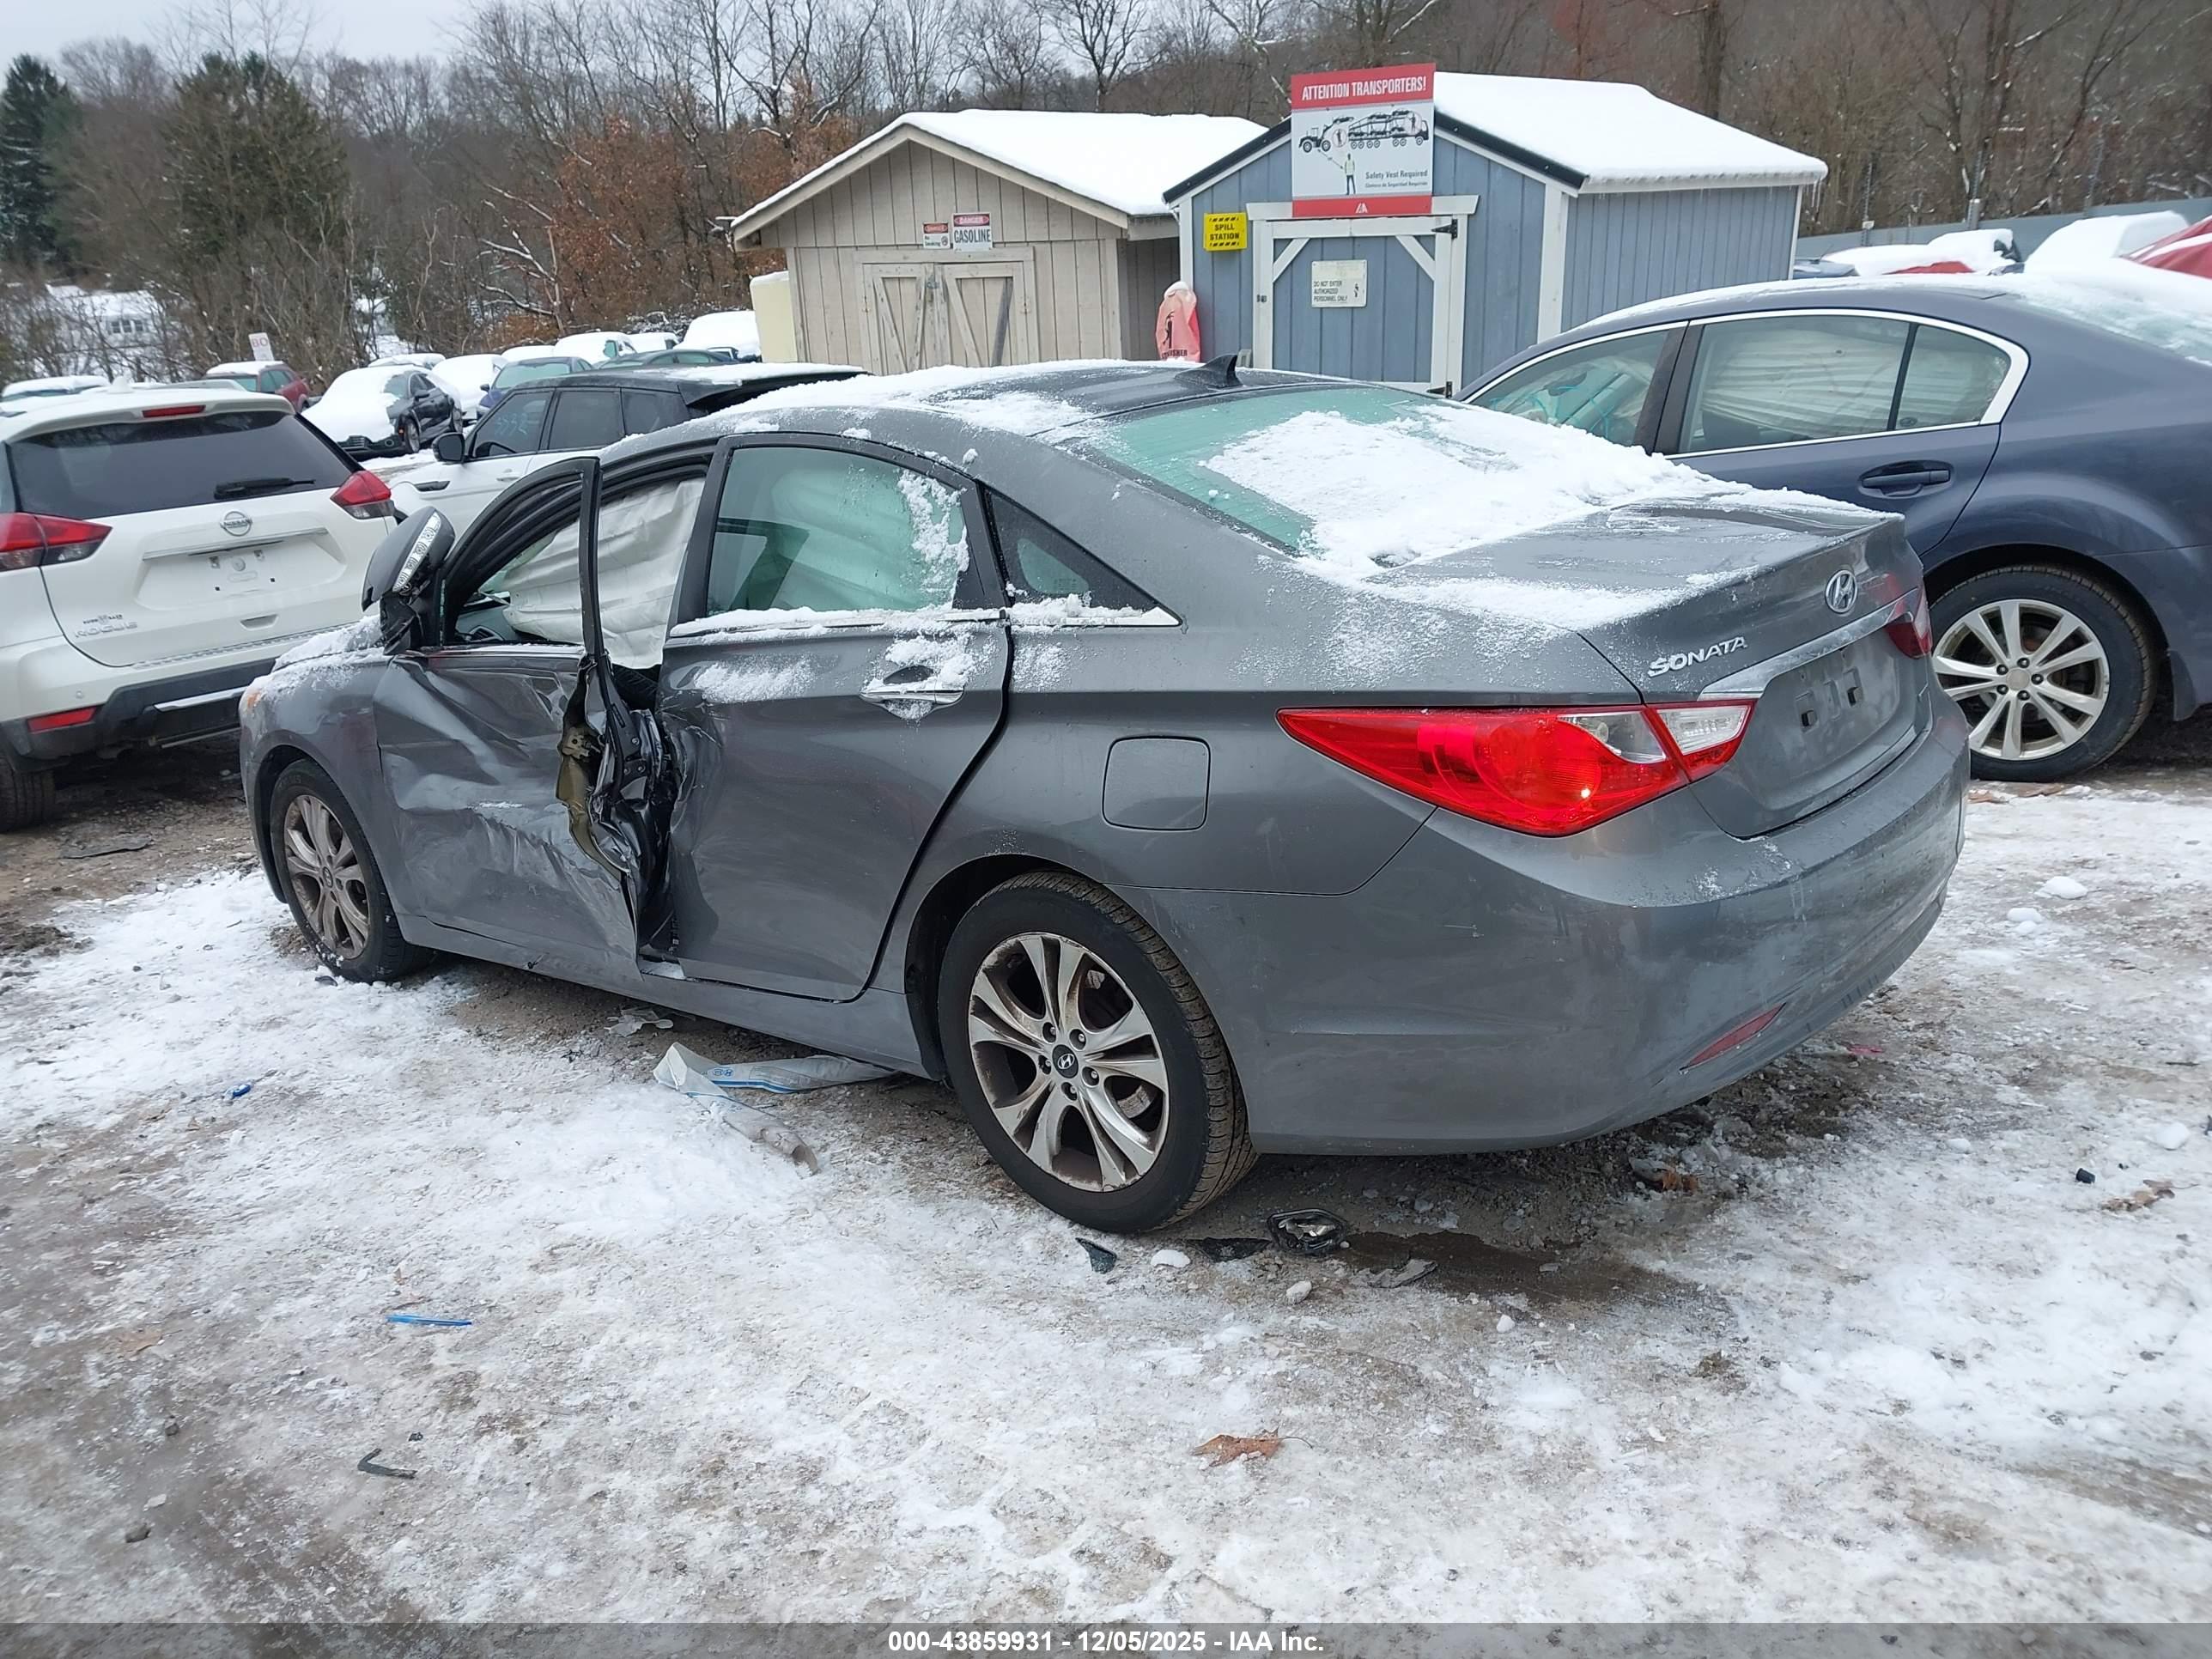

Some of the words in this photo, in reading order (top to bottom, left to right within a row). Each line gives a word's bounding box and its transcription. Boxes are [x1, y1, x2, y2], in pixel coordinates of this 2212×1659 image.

[1302, 82, 1349, 100] ATTENTION
[1352, 76, 1426, 97] TRANSPORTERS!
[1365, 172, 1383, 180] Safety
[1401, 170, 1428, 179] Required
[1214, 222, 1235, 231] SPILL
[954, 229, 991, 243] GASOLINE
[1210, 232, 1239, 240] STATION
[75, 622, 137, 638] ROGUE
[1647, 635, 1747, 677] SONATA
